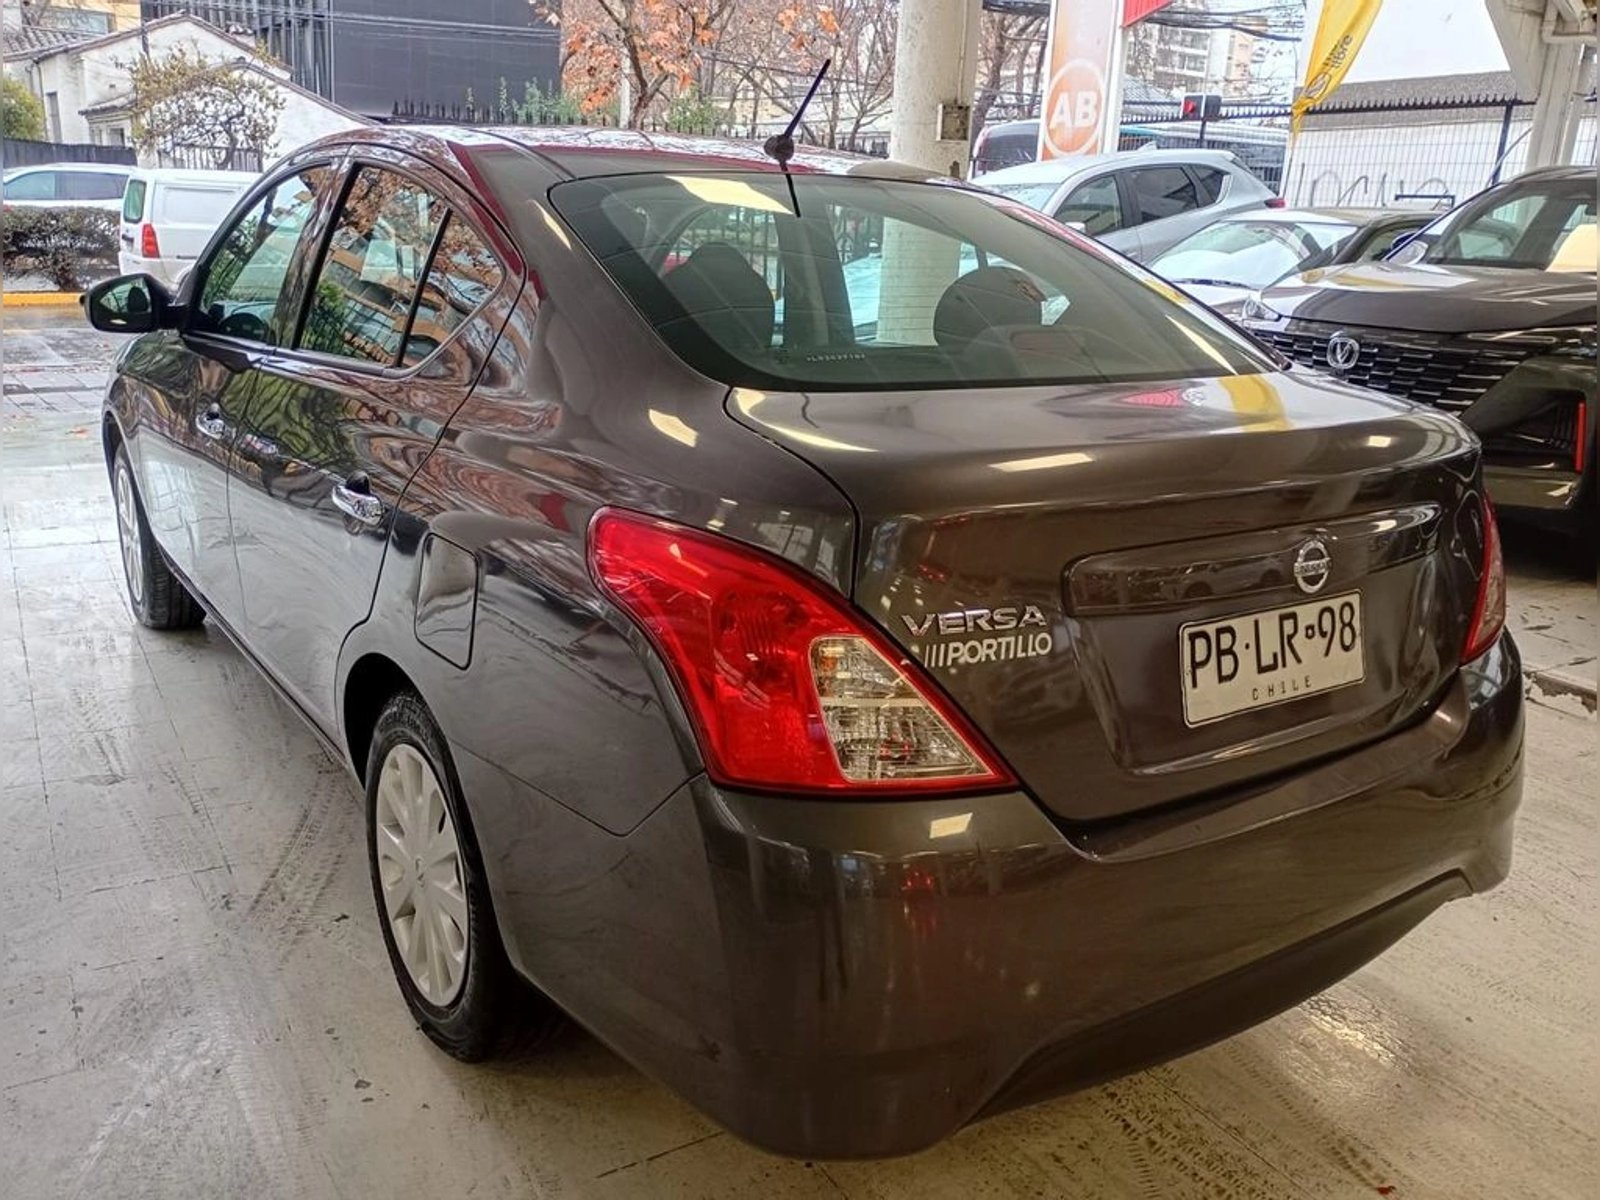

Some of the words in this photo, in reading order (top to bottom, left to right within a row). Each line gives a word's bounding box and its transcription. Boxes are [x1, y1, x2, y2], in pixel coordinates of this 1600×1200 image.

[1049, 91, 1100, 130] AB
[901, 604, 1047, 636] VERSA
[946, 632, 1052, 667] PORTILLO
[1252, 675, 1312, 701] CHILE
